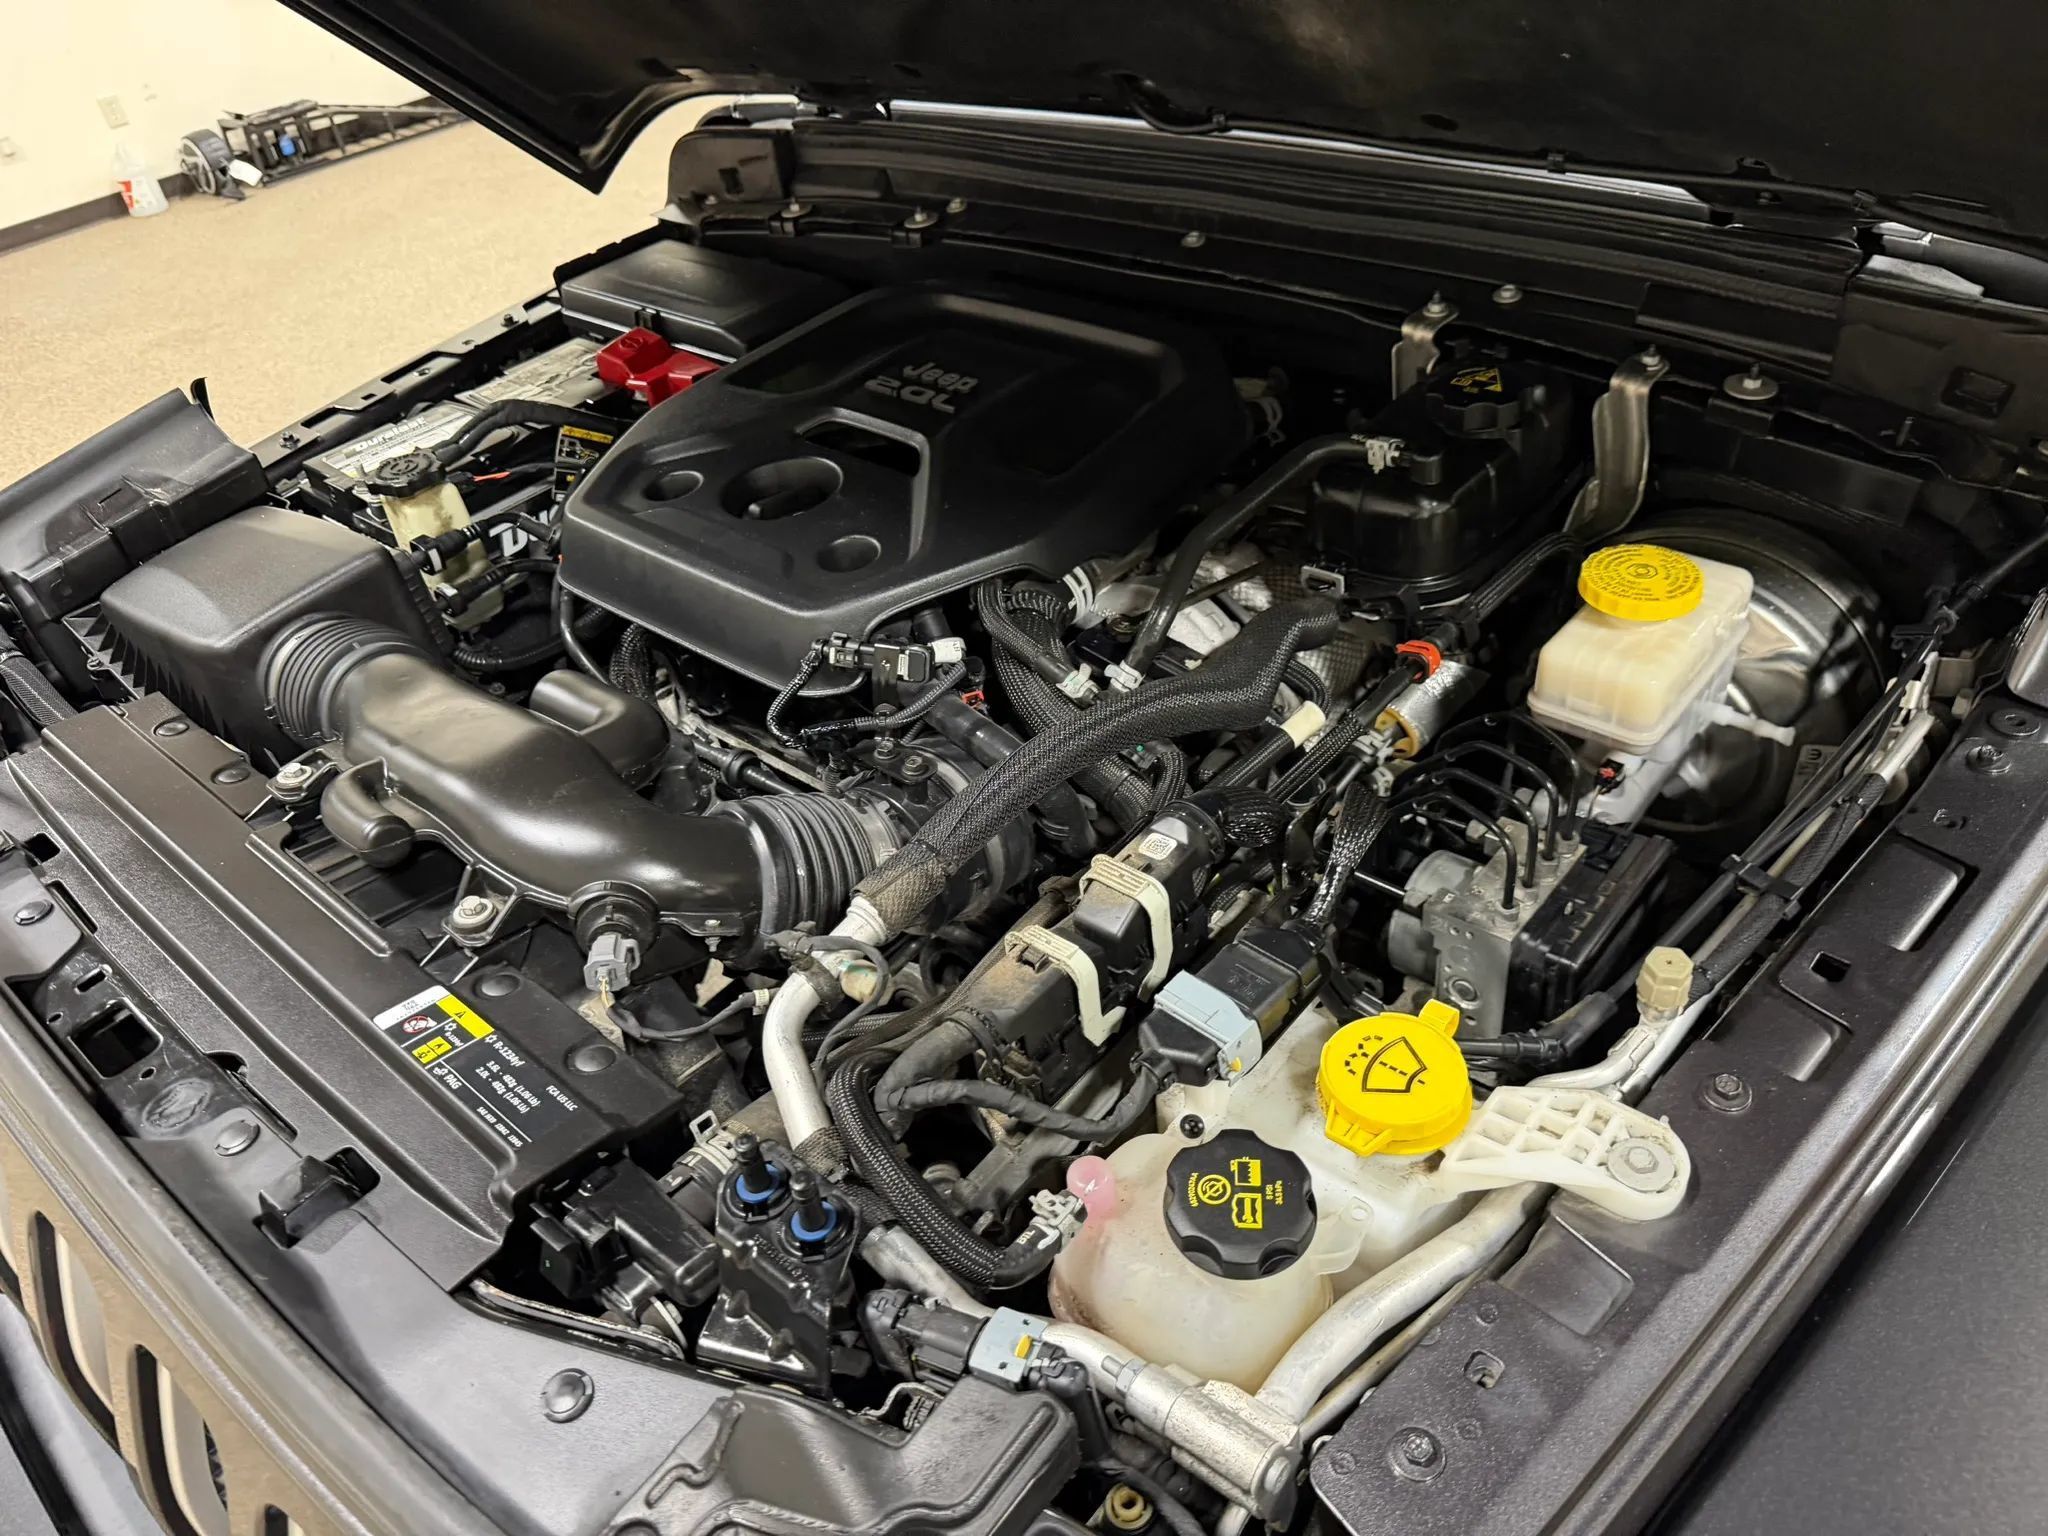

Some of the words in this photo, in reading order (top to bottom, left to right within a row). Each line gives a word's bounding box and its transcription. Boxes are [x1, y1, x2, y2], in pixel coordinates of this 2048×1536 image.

[903, 362, 979, 394] Jeep
[493, 1041, 525, 1067] R-1234yf
[443, 1074, 463, 1090] PAG
[545, 1085, 560, 1097] FCA
[556, 1094, 569, 1104] US
[563, 1101, 578, 1112] LLC
